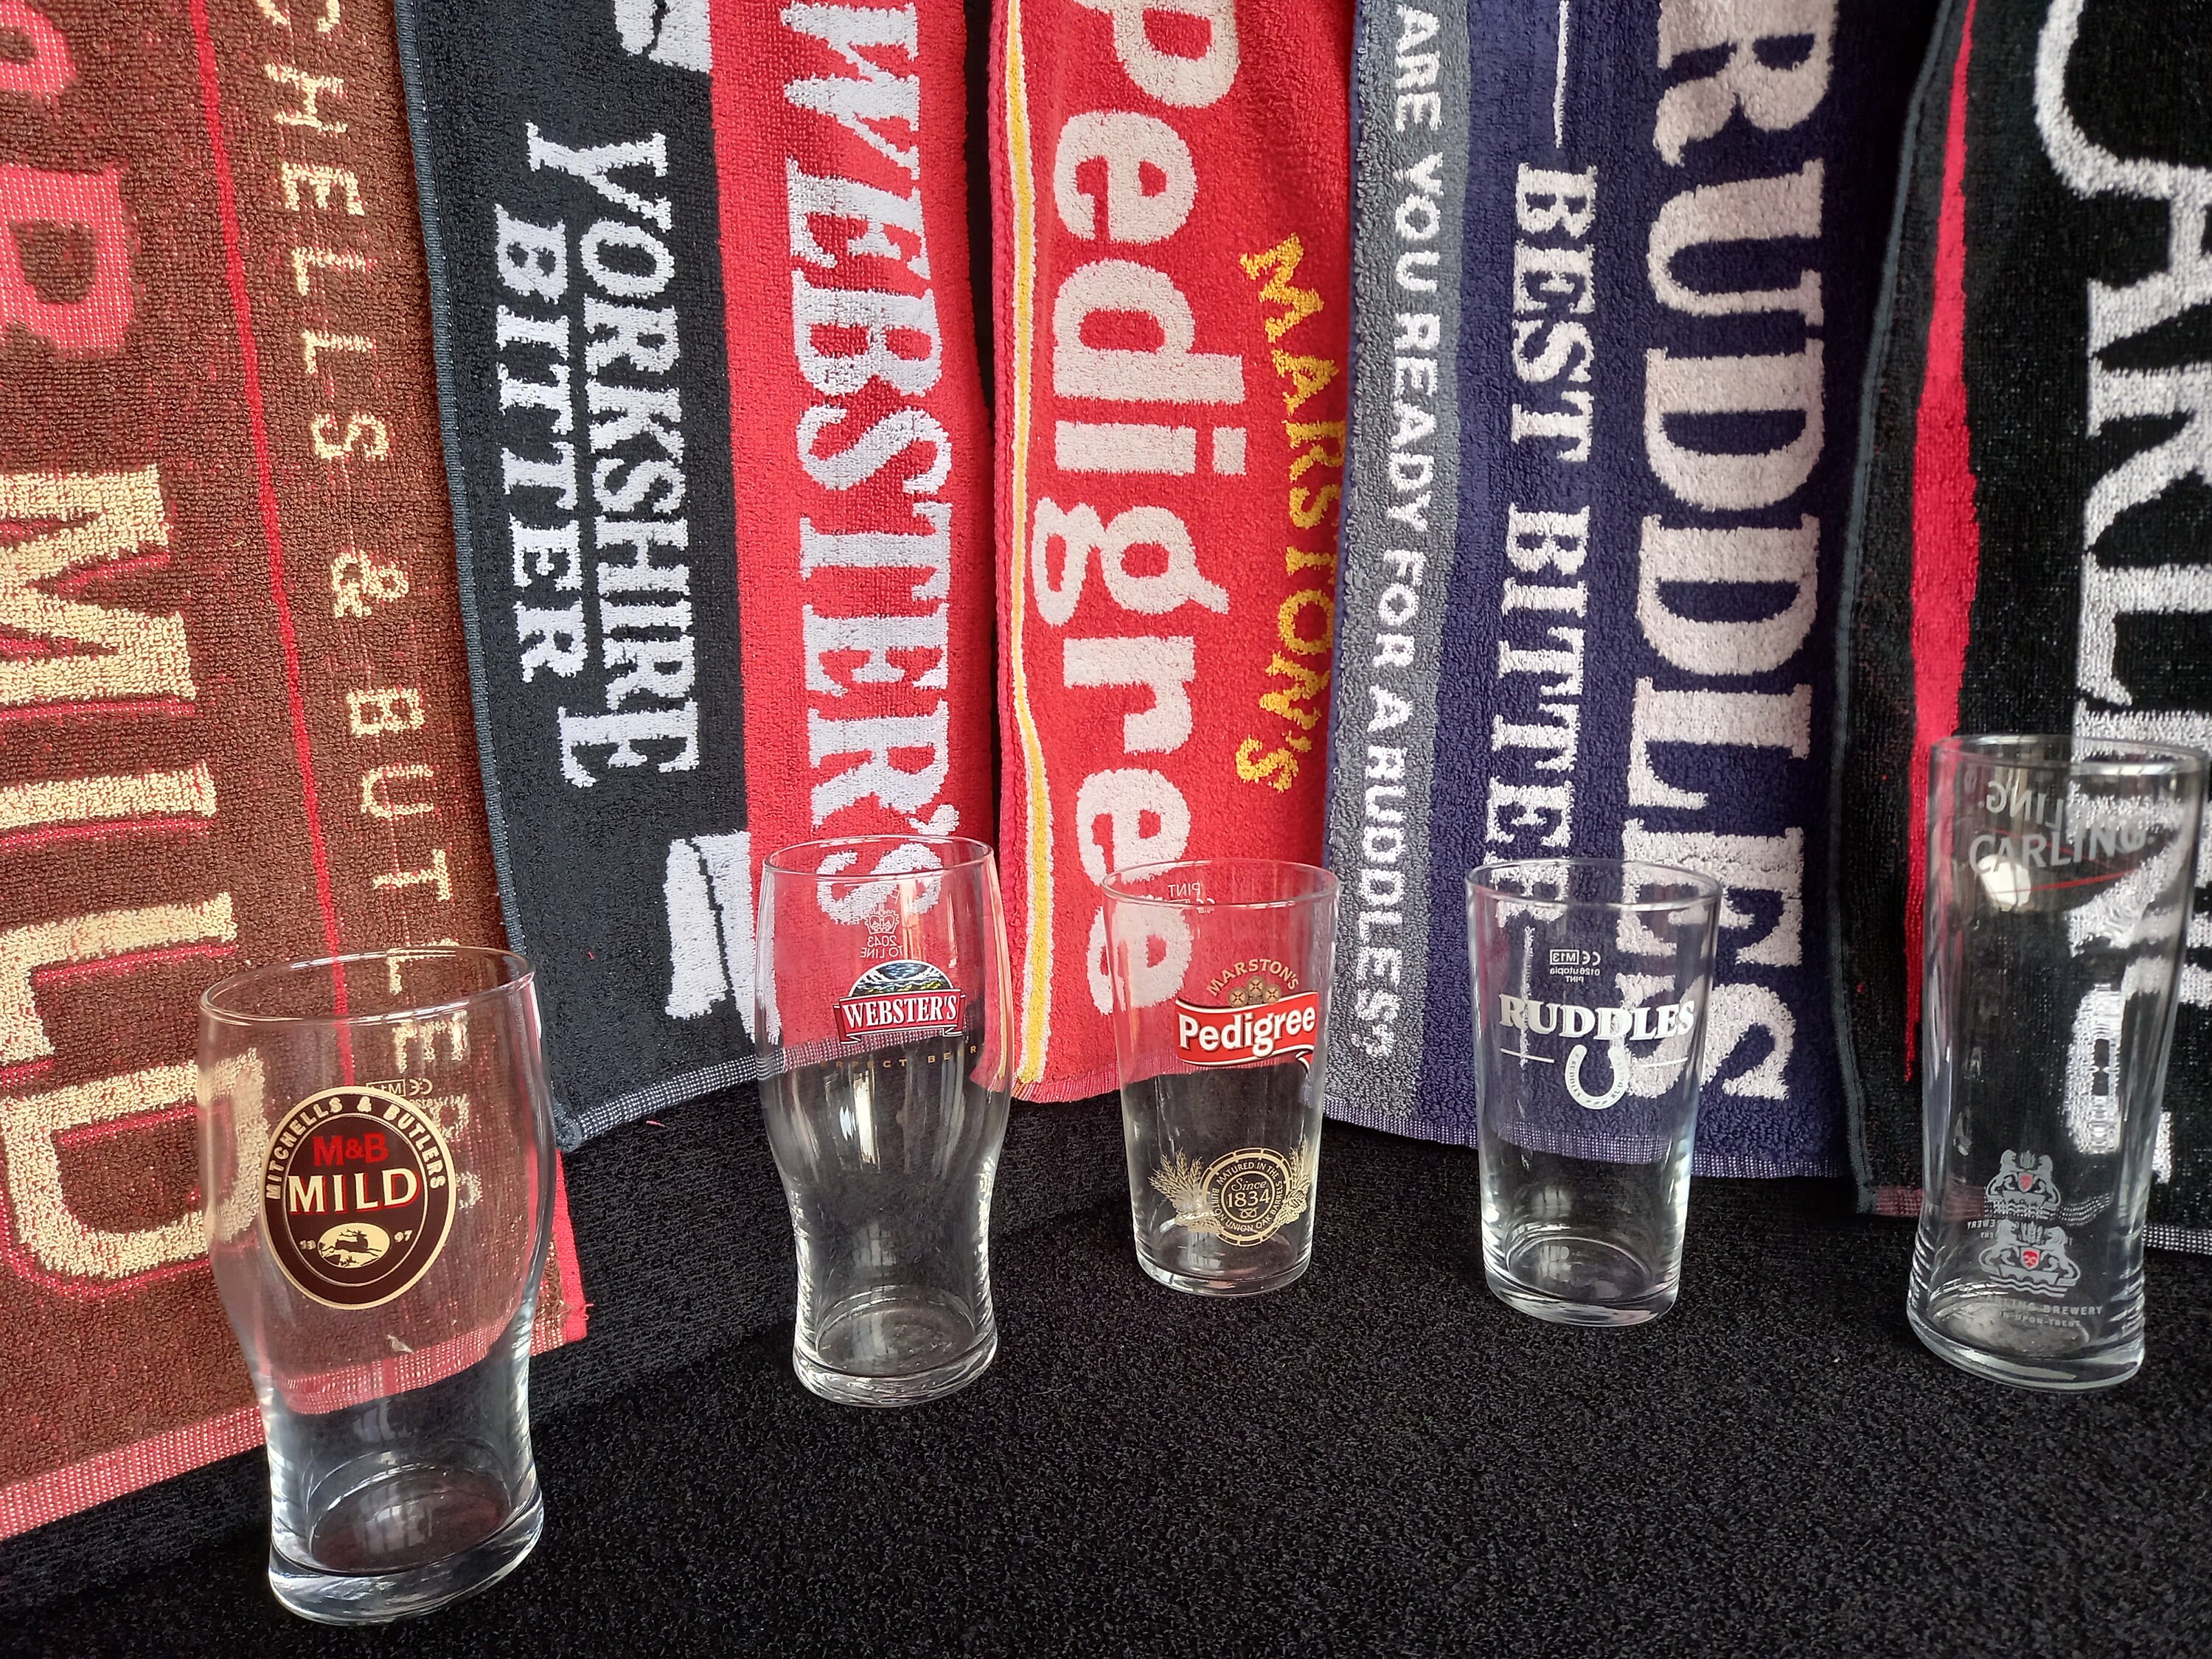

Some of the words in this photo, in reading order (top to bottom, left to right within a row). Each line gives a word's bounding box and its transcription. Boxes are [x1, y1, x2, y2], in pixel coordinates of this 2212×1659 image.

[1394, 6, 1441, 132] ARE
[1394, 152, 1444, 294] YOU
[1509, 162, 1599, 463] BEST
[493, 204, 588, 683] BITTER
[1383, 313, 1441, 531] READY
[525, 120, 700, 787] YORKSHIRE
[780, 0, 959, 925] WEBSTER'S
[1239, 232, 1347, 793] MARSTON'S
[1615, 0, 1839, 1101] RUDDLES
[331, 549, 410, 619] &
[1372, 549, 1425, 669] FOR
[1366, 684, 1413, 733] A
[1483, 503, 1593, 927] BITTER
[0, 465, 270, 1281] MILD
[1968, 823, 2149, 875] CARLING
[1206, 958, 1300, 997] MARSTON'S
[841, 995, 958, 1029] WEBSTER'S
[1177, 1006, 1317, 1059] Pedigree
[1498, 992, 1696, 1041] RUDDLES
[820, 1058, 908, 1068] ERFECT
[265, 1096, 344, 1200] MITCHELLS
[357, 1096, 372, 1114] &
[383, 1103, 446, 1189] BUTLERS
[312, 1131, 389, 1167] M&B
[1216, 1161, 1256, 1186] MATURED
[1256, 1161, 1267, 1172] IN
[1267, 1164, 1281, 1180] THE
[287, 1167, 421, 1216] MILD
[1211, 1188, 1227, 1222] BURTON
[1225, 1218, 1255, 1233] UNION
[1255, 1214, 1273, 1229] OAK
[1270, 1180, 1284, 1215] BARRELS
[1228, 1189, 1271, 1208] 1834
[1231, 1178, 1268, 1192] Since
[394, 1229, 413, 1243] 97
[2044, 1304, 2103, 1315] BREWERY
